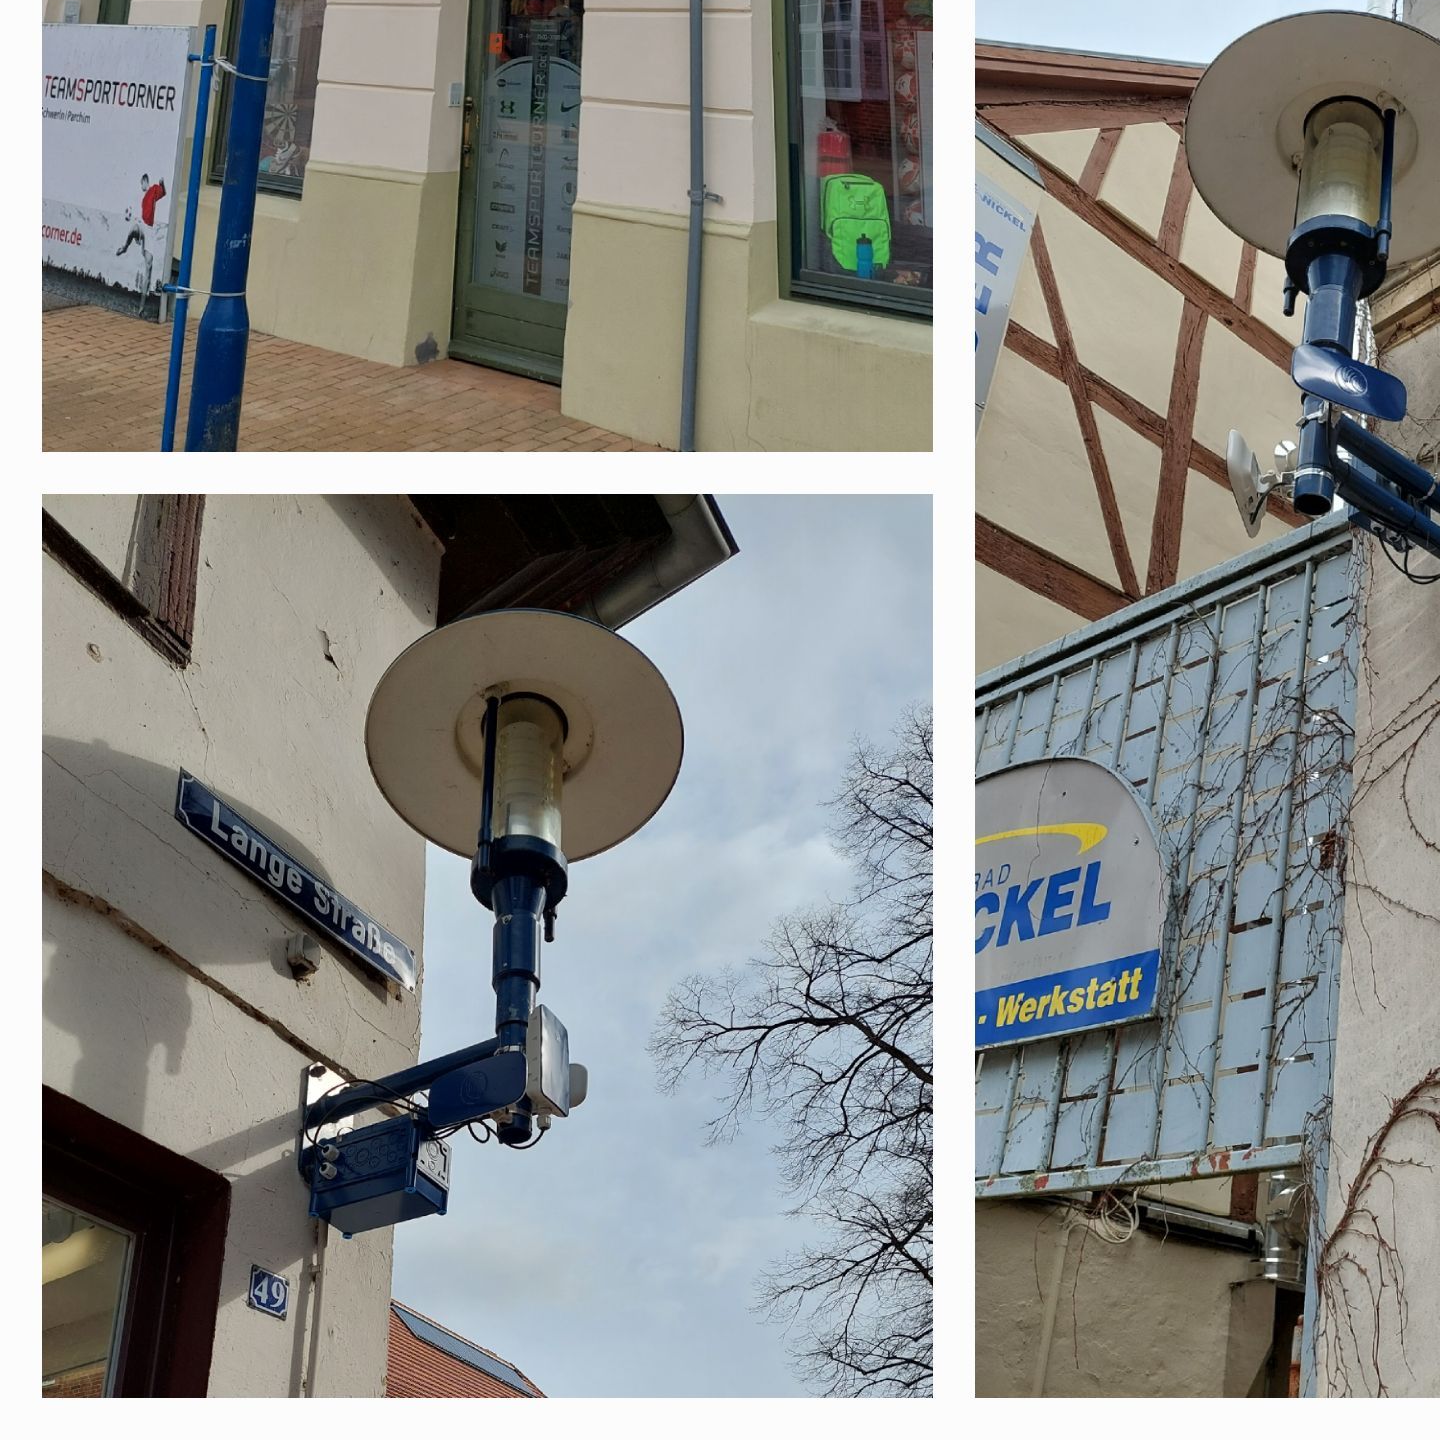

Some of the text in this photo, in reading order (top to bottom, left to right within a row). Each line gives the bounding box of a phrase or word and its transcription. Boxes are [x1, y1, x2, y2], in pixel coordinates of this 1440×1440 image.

[44, 74, 176, 112] TEAMSPORTCORNER
[980, 194, 1026, 232] NICKEL
[211, 799, 397, 965] Lange Straße
[996, 967, 1143, 1028] Werkstatt
[254, 1276, 286, 1308] 49
